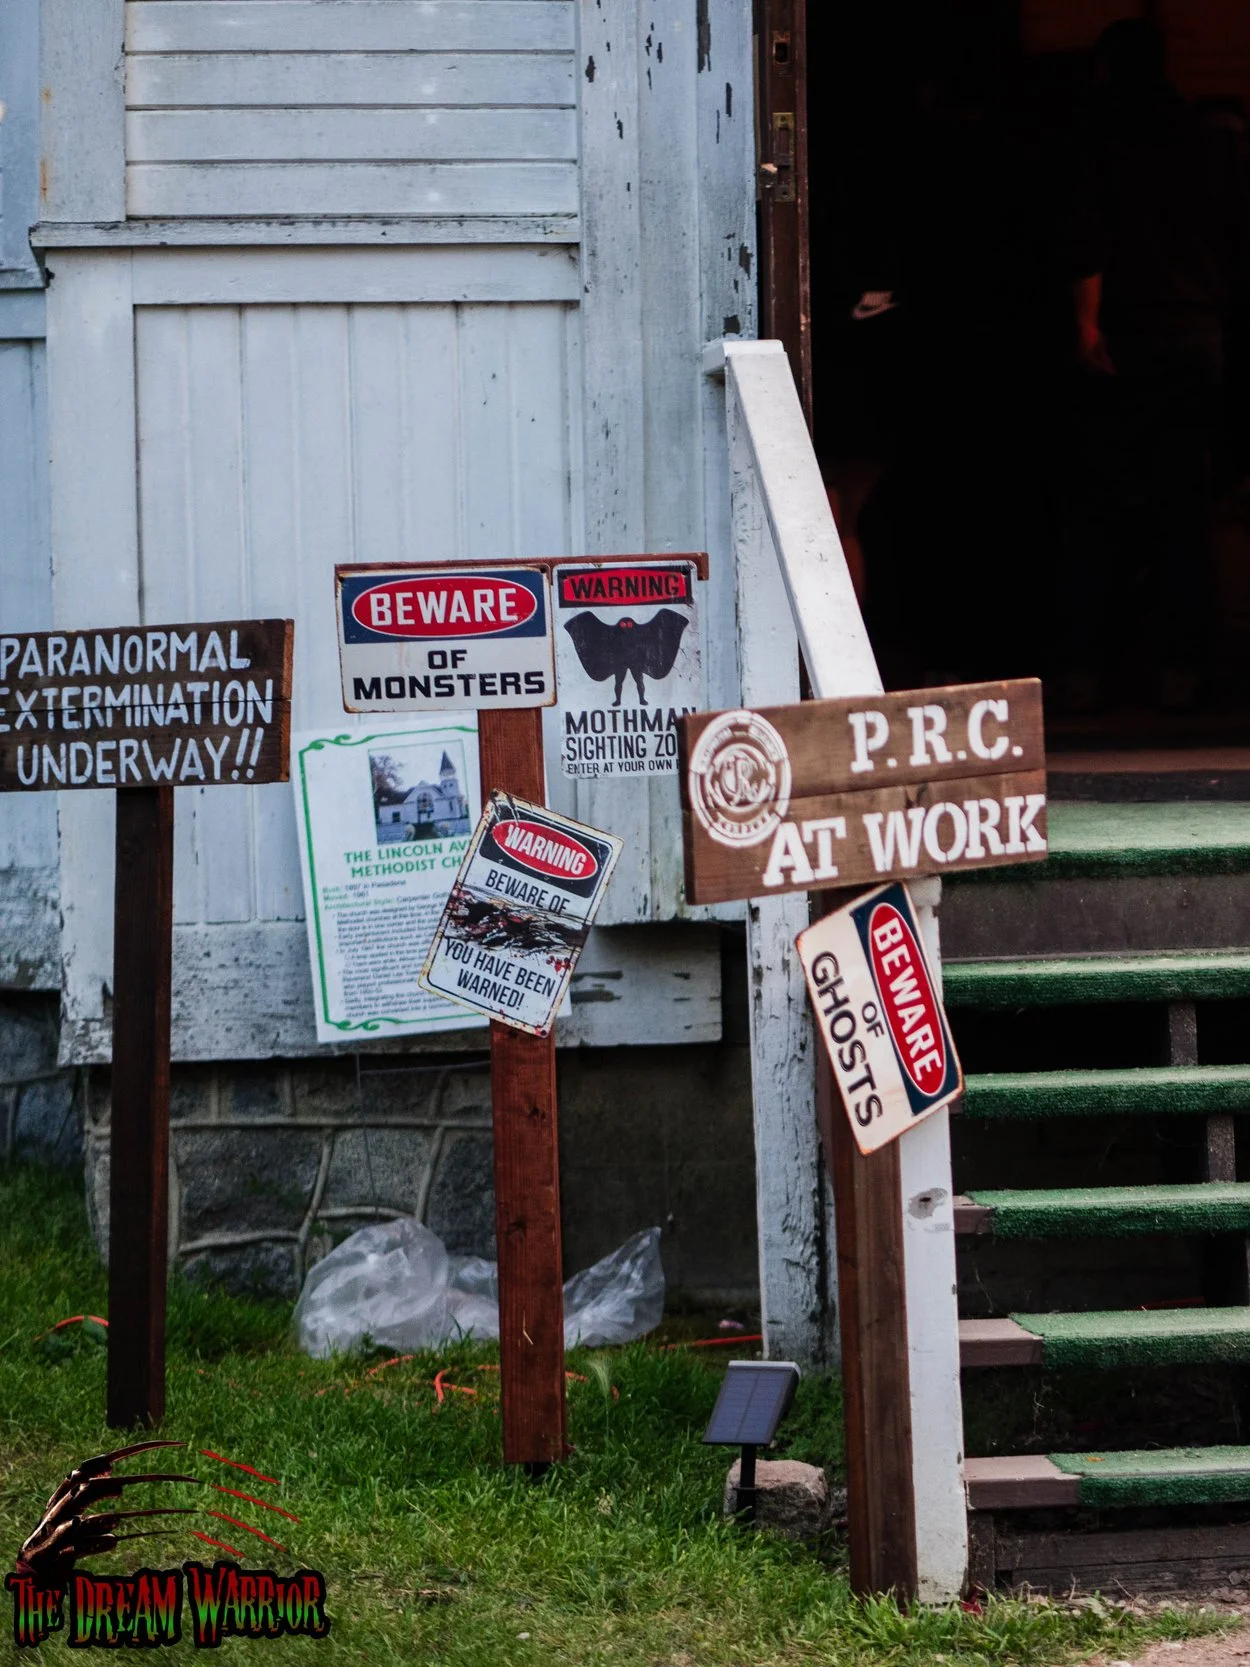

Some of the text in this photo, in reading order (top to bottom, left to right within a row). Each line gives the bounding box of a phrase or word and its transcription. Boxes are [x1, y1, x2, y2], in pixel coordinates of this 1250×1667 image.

[370, 587, 518, 626] BEWARE
[570, 574, 680, 599] WARNING
[0, 630, 250, 680] PARANORMAL
[427, 649, 467, 670] OF
[353, 671, 545, 700] MONSTERS
[17, 727, 265, 786] UNDERWAY!!
[566, 733, 677, 761] SIGHTING ZO
[848, 699, 1023, 773] P.R.C.
[568, 762, 599, 775] ENTER
[603, 762, 616, 773] AT
[618, 760, 645, 772] YOUR
[648, 759, 672, 771] OWN
[344, 849, 372, 864] THE
[378, 842, 443, 861] LINCOLN
[505, 824, 587, 876] WARNING
[763, 794, 1047, 887] AT WORK
[351, 855, 461, 878] METHODIST CH
[485, 868, 571, 914] BEWARE OF
[444, 938, 556, 998] YOU HAVE BEEN
[457, 968, 525, 1010] WARNED!
[861, 1000, 885, 1039] OF
[872, 916, 942, 1082] BEWARE
[811, 950, 884, 1128] GHOSTS
